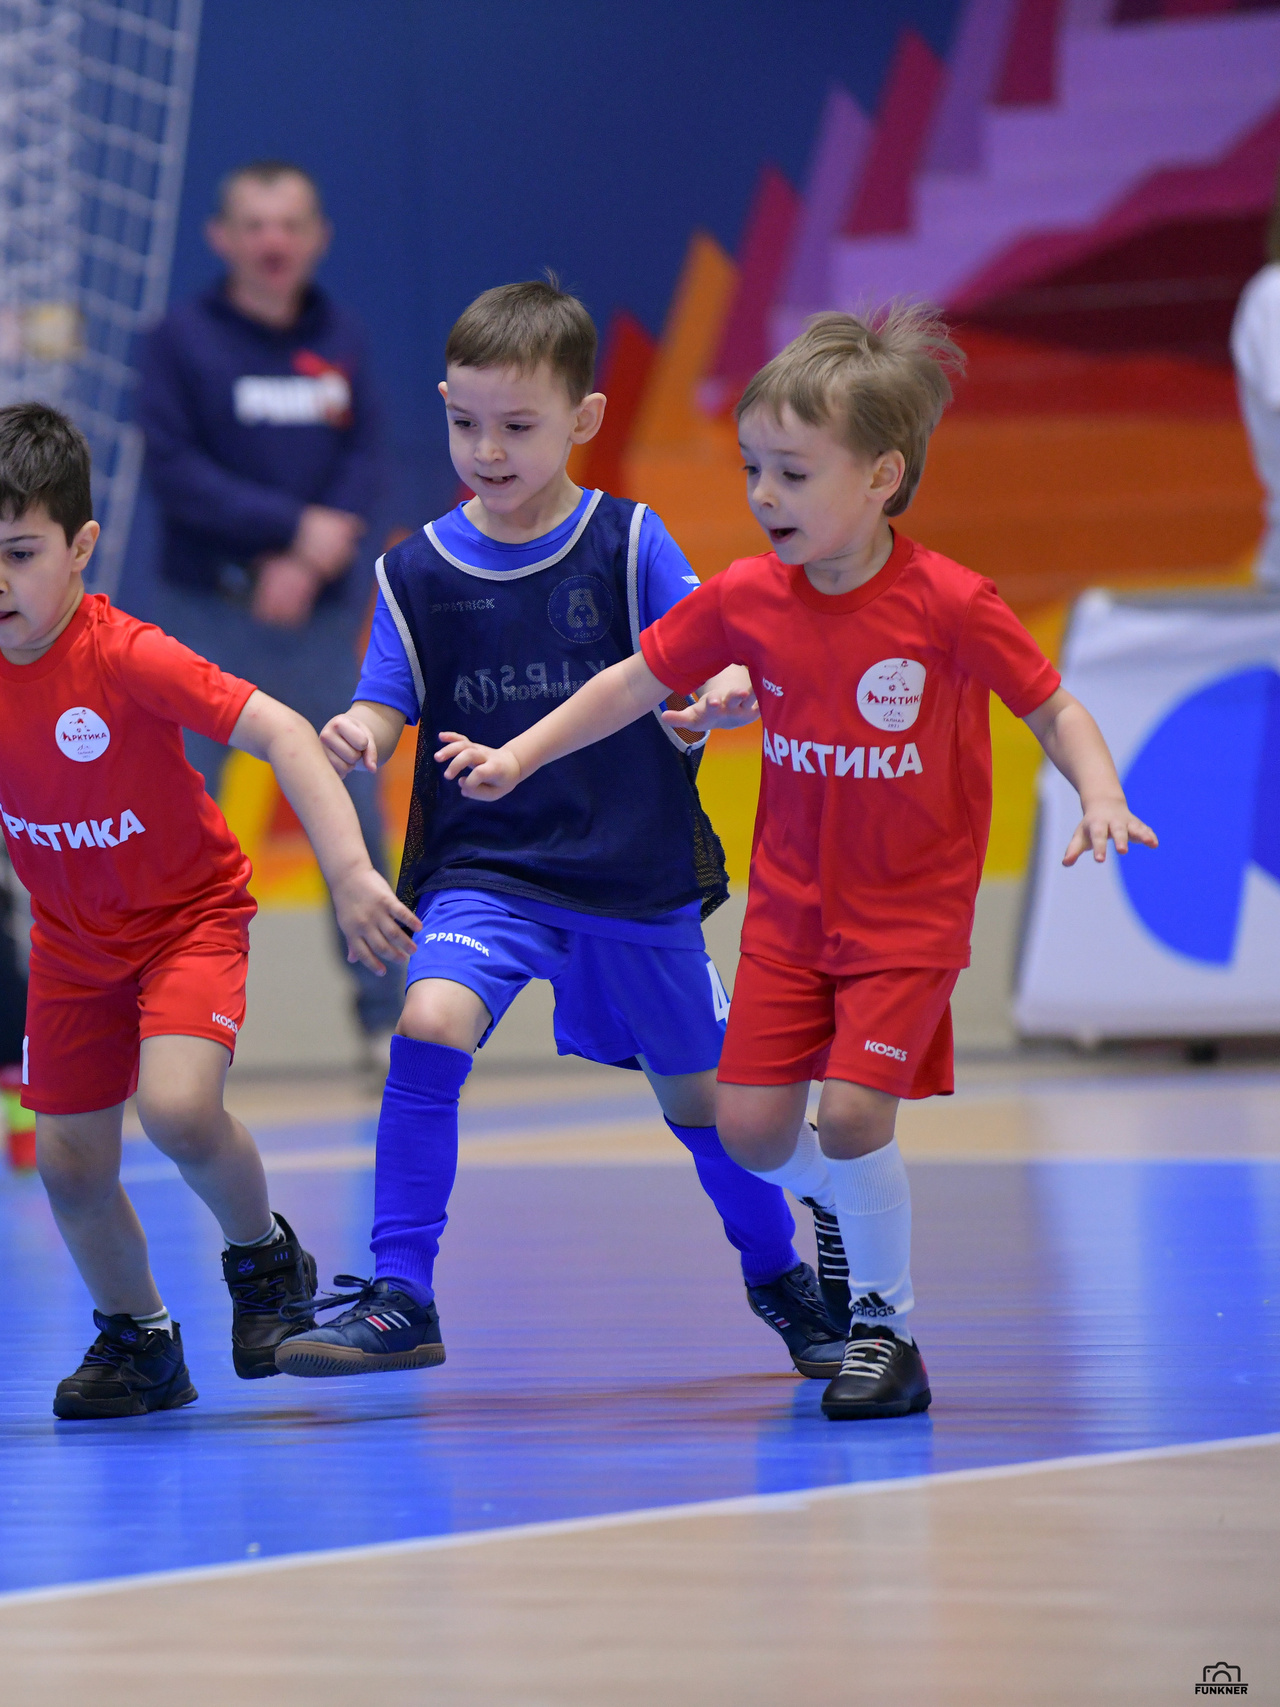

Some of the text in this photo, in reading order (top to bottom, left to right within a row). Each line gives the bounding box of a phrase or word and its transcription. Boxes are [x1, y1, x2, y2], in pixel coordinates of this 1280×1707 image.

[860, 690, 922, 705] АРКТИК
[59, 731, 108, 742] АРКТИКА
[763, 727, 924, 780] АРКТИКА
[437, 932, 490, 958] PATRICK
[864, 1039, 908, 1063] KODES
[850, 1305, 896, 1318] adidas
